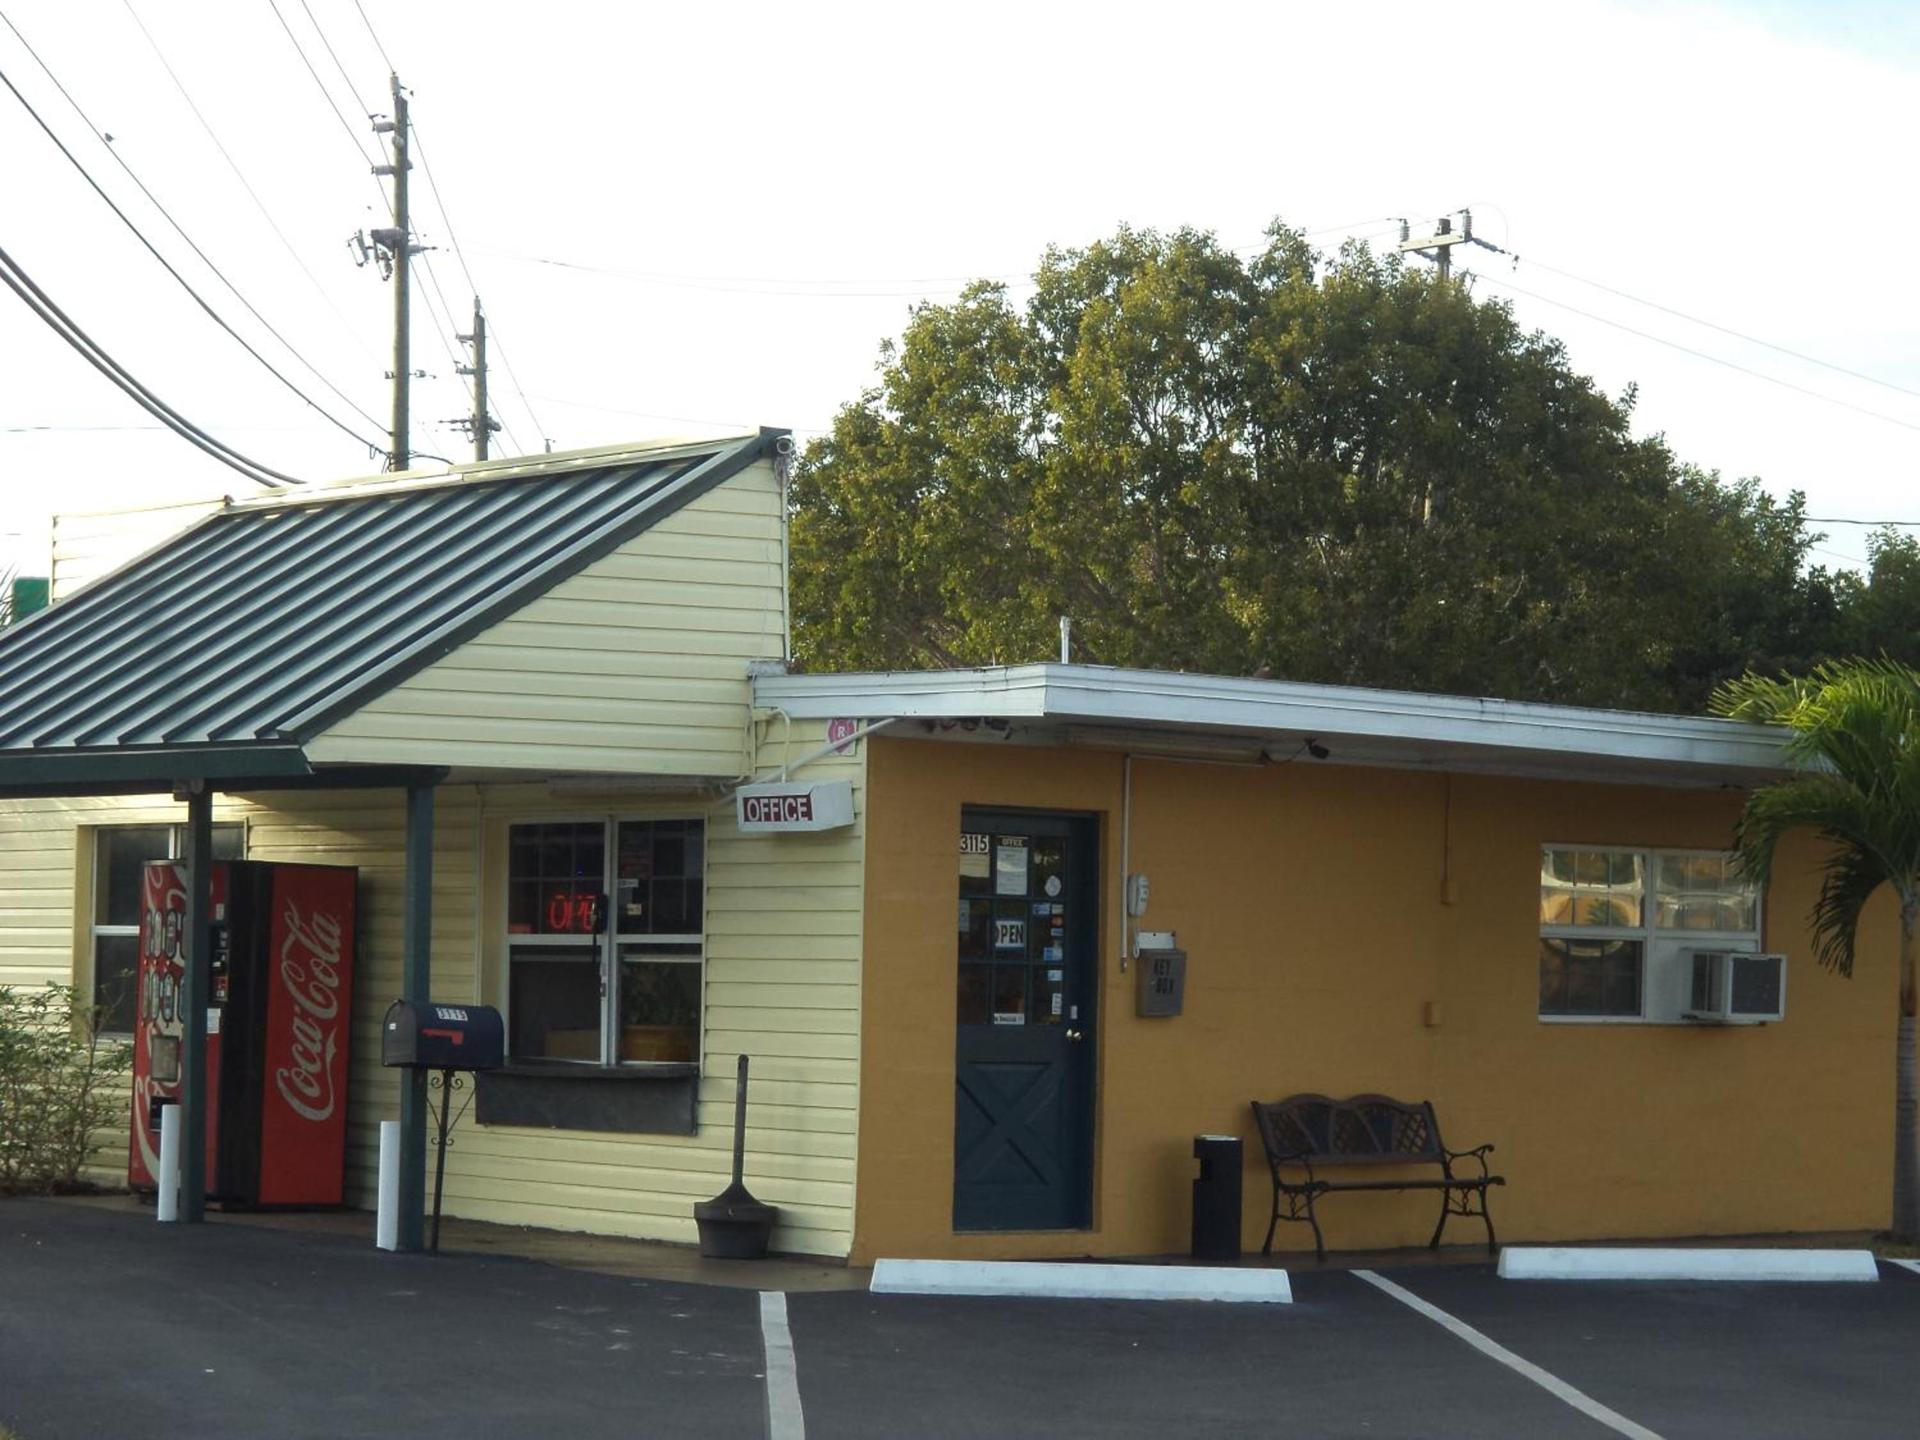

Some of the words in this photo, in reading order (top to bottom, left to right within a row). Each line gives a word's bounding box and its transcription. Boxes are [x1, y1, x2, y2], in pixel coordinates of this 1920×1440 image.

[746, 797, 809, 822] OFFICE
[959, 835, 988, 852] 3115
[549, 893, 595, 931] OPE
[275, 896, 343, 1122] Coca-Cola
